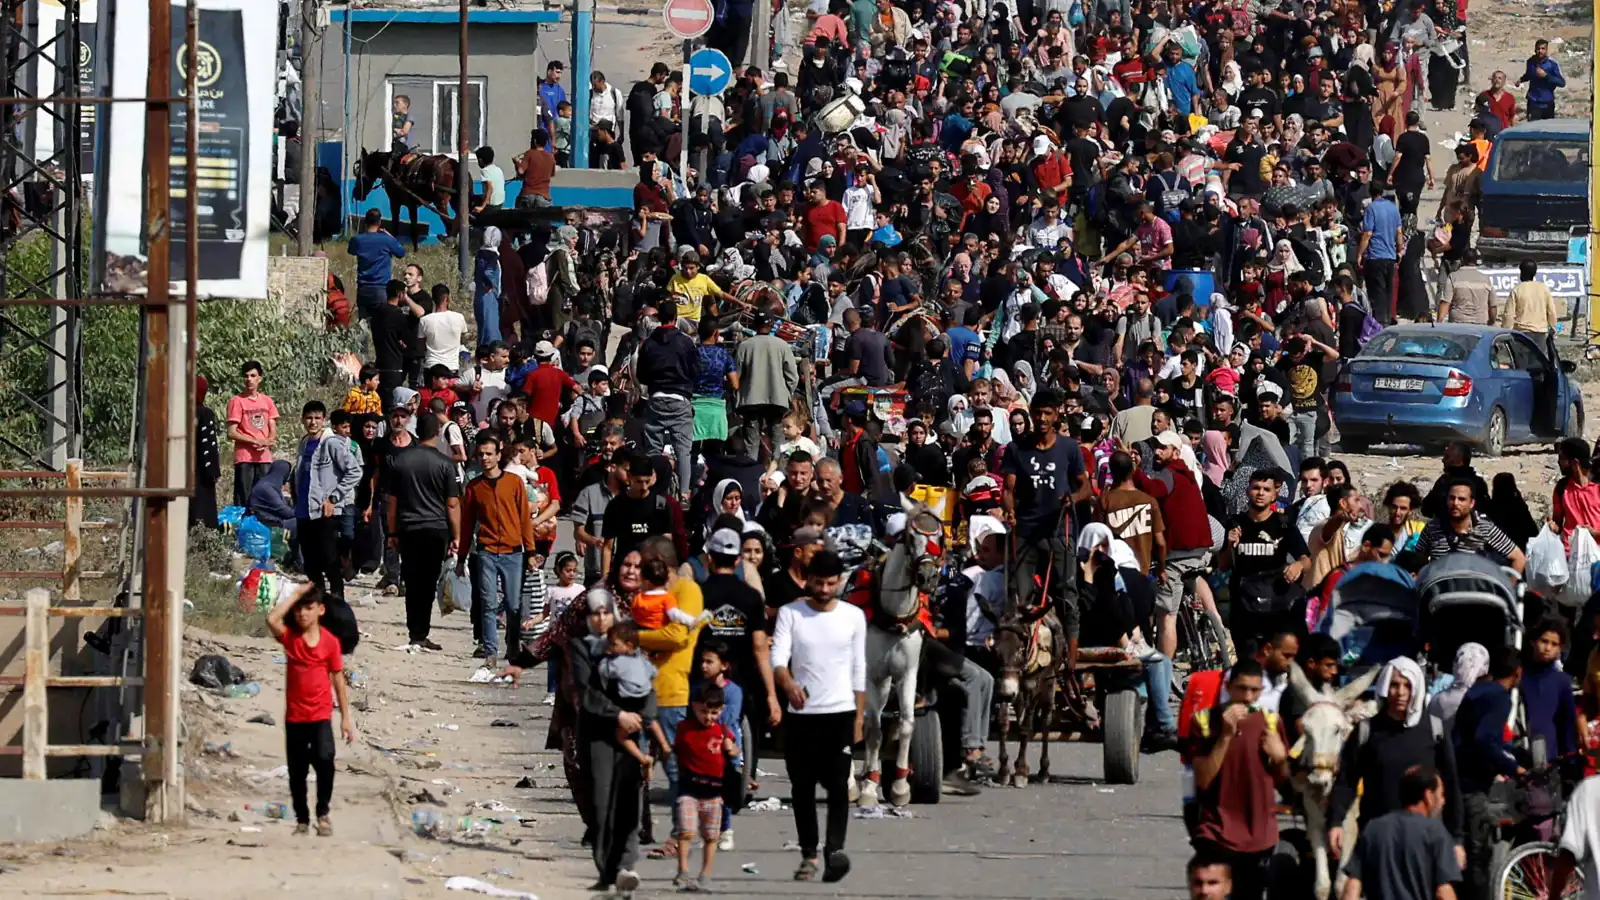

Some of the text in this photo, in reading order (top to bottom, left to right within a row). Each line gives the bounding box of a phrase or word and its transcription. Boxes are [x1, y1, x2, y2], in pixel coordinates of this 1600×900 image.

[1489, 275, 1519, 290] LICE
[1542, 273, 1576, 291] شرط
[1108, 503, 1152, 538] NIKE
[1238, 543, 1274, 556] PUMA
